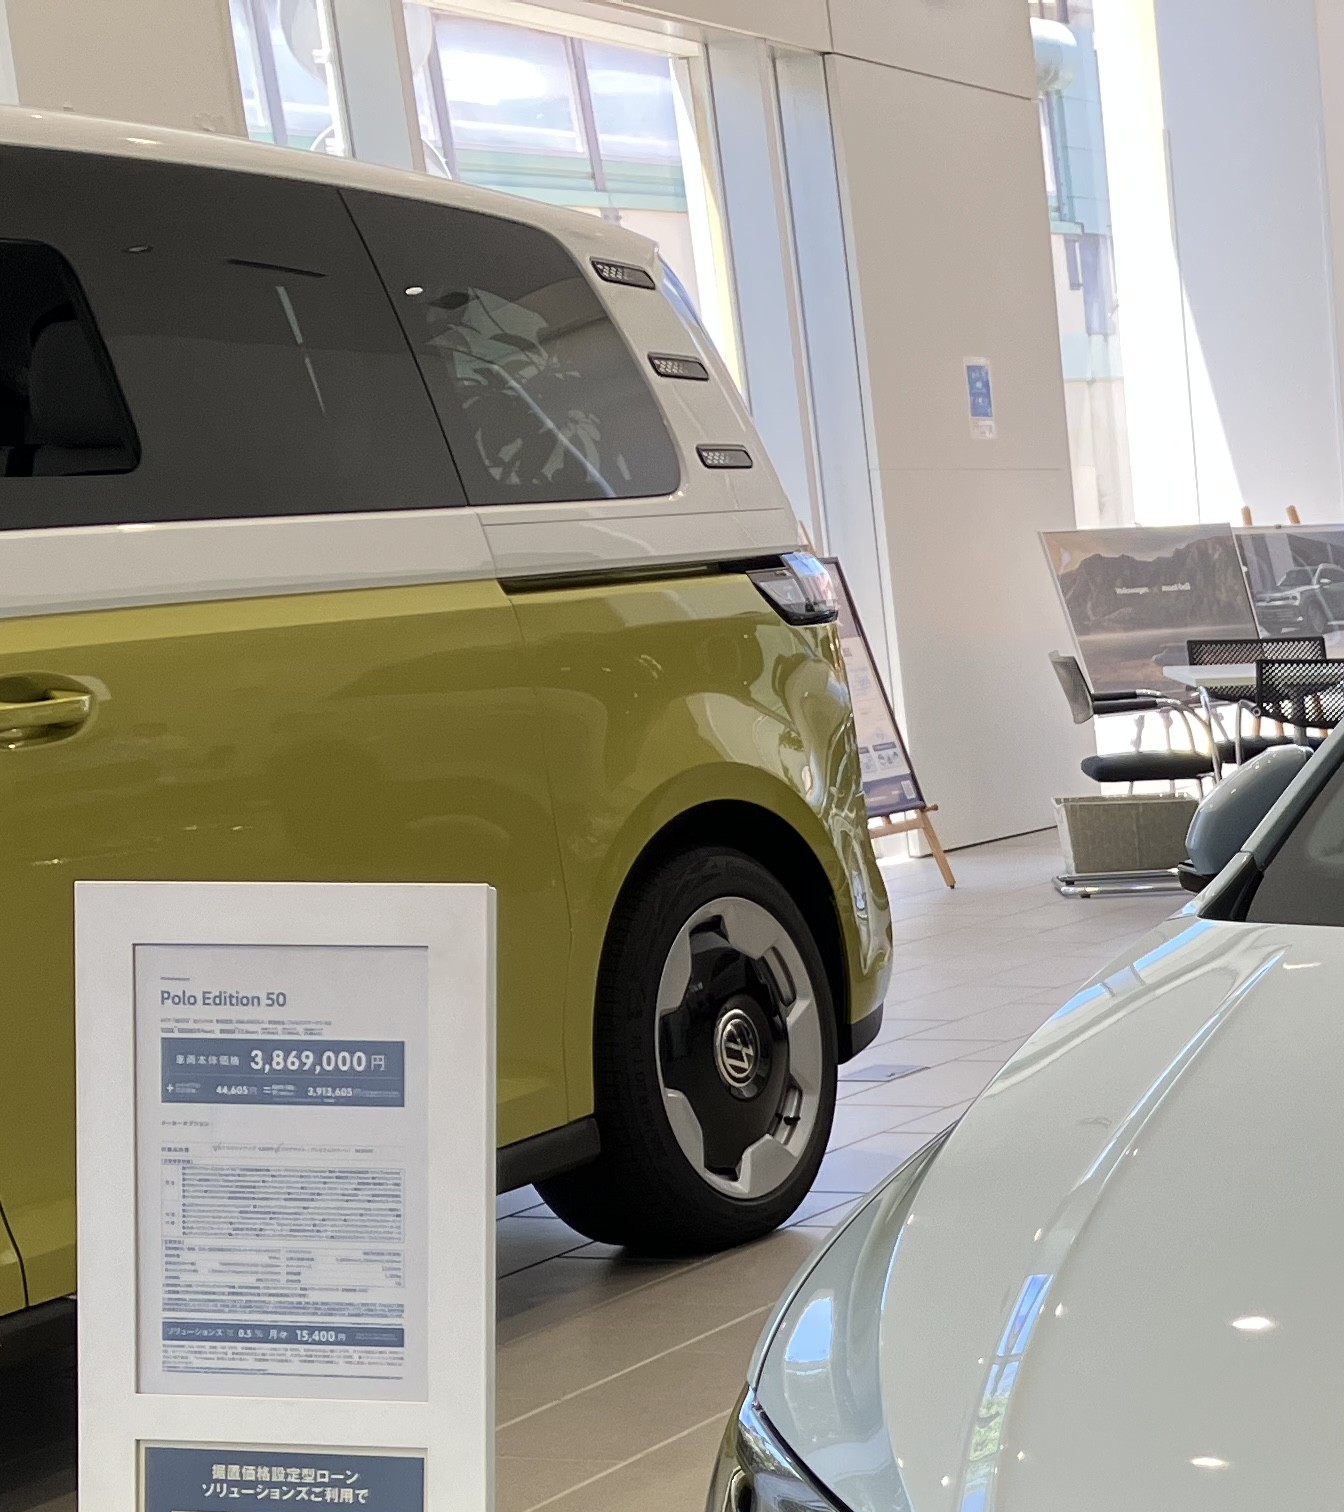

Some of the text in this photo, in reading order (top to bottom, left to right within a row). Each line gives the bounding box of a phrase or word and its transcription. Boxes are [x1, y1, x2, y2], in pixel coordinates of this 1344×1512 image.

[160, 990, 287, 1007] Polo Edition 50
[202, 1483, 369, 1504] ソリューションズご利用で
